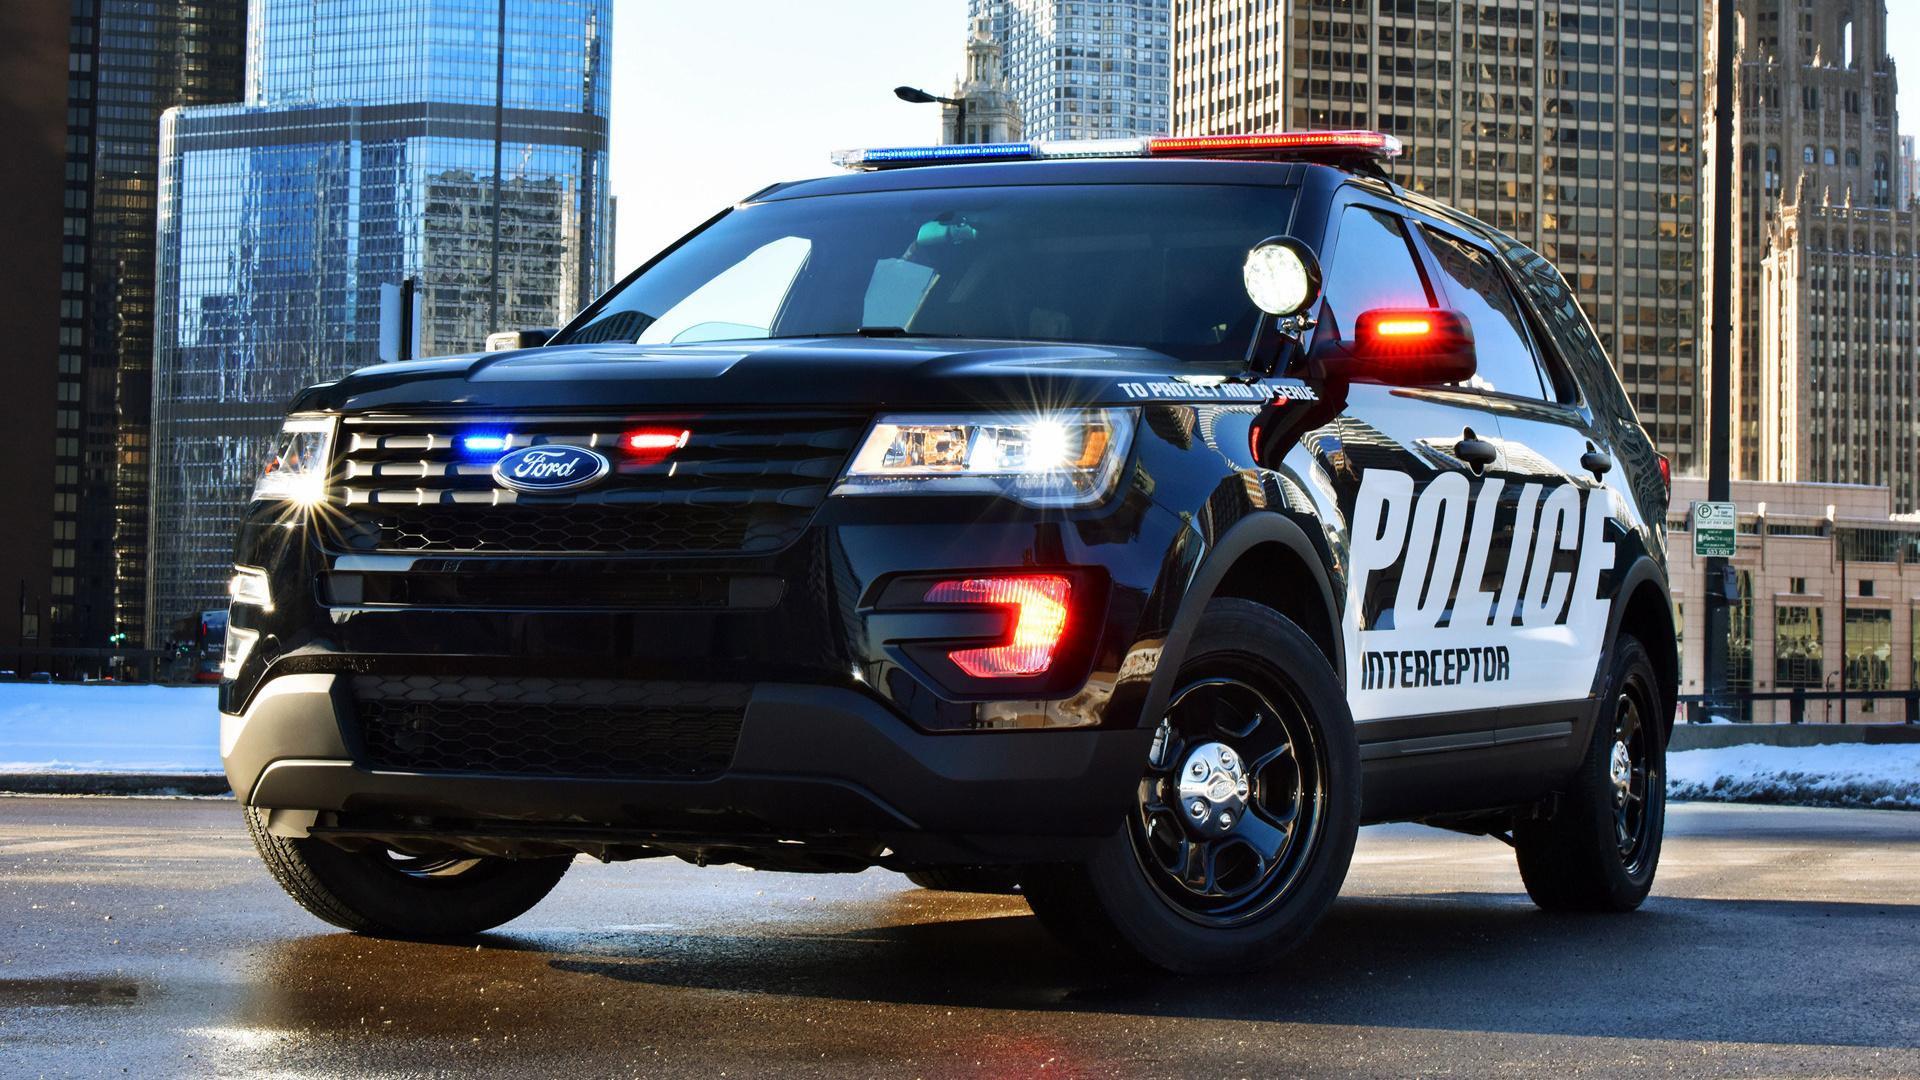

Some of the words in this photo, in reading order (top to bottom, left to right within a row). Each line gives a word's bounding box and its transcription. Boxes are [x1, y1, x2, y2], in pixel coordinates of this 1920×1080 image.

[1118, 383, 1148, 398] TO
[1147, 382, 1221, 398] PROTECT
[1221, 383, 1250, 398] AND
[1250, 384, 1273, 399] TO
[1272, 385, 1320, 401] SERVE
[514, 451, 580, 478] Ford
[1349, 468, 1616, 631] POLICE
[1361, 646, 1510, 690] INTERCEPTOR
